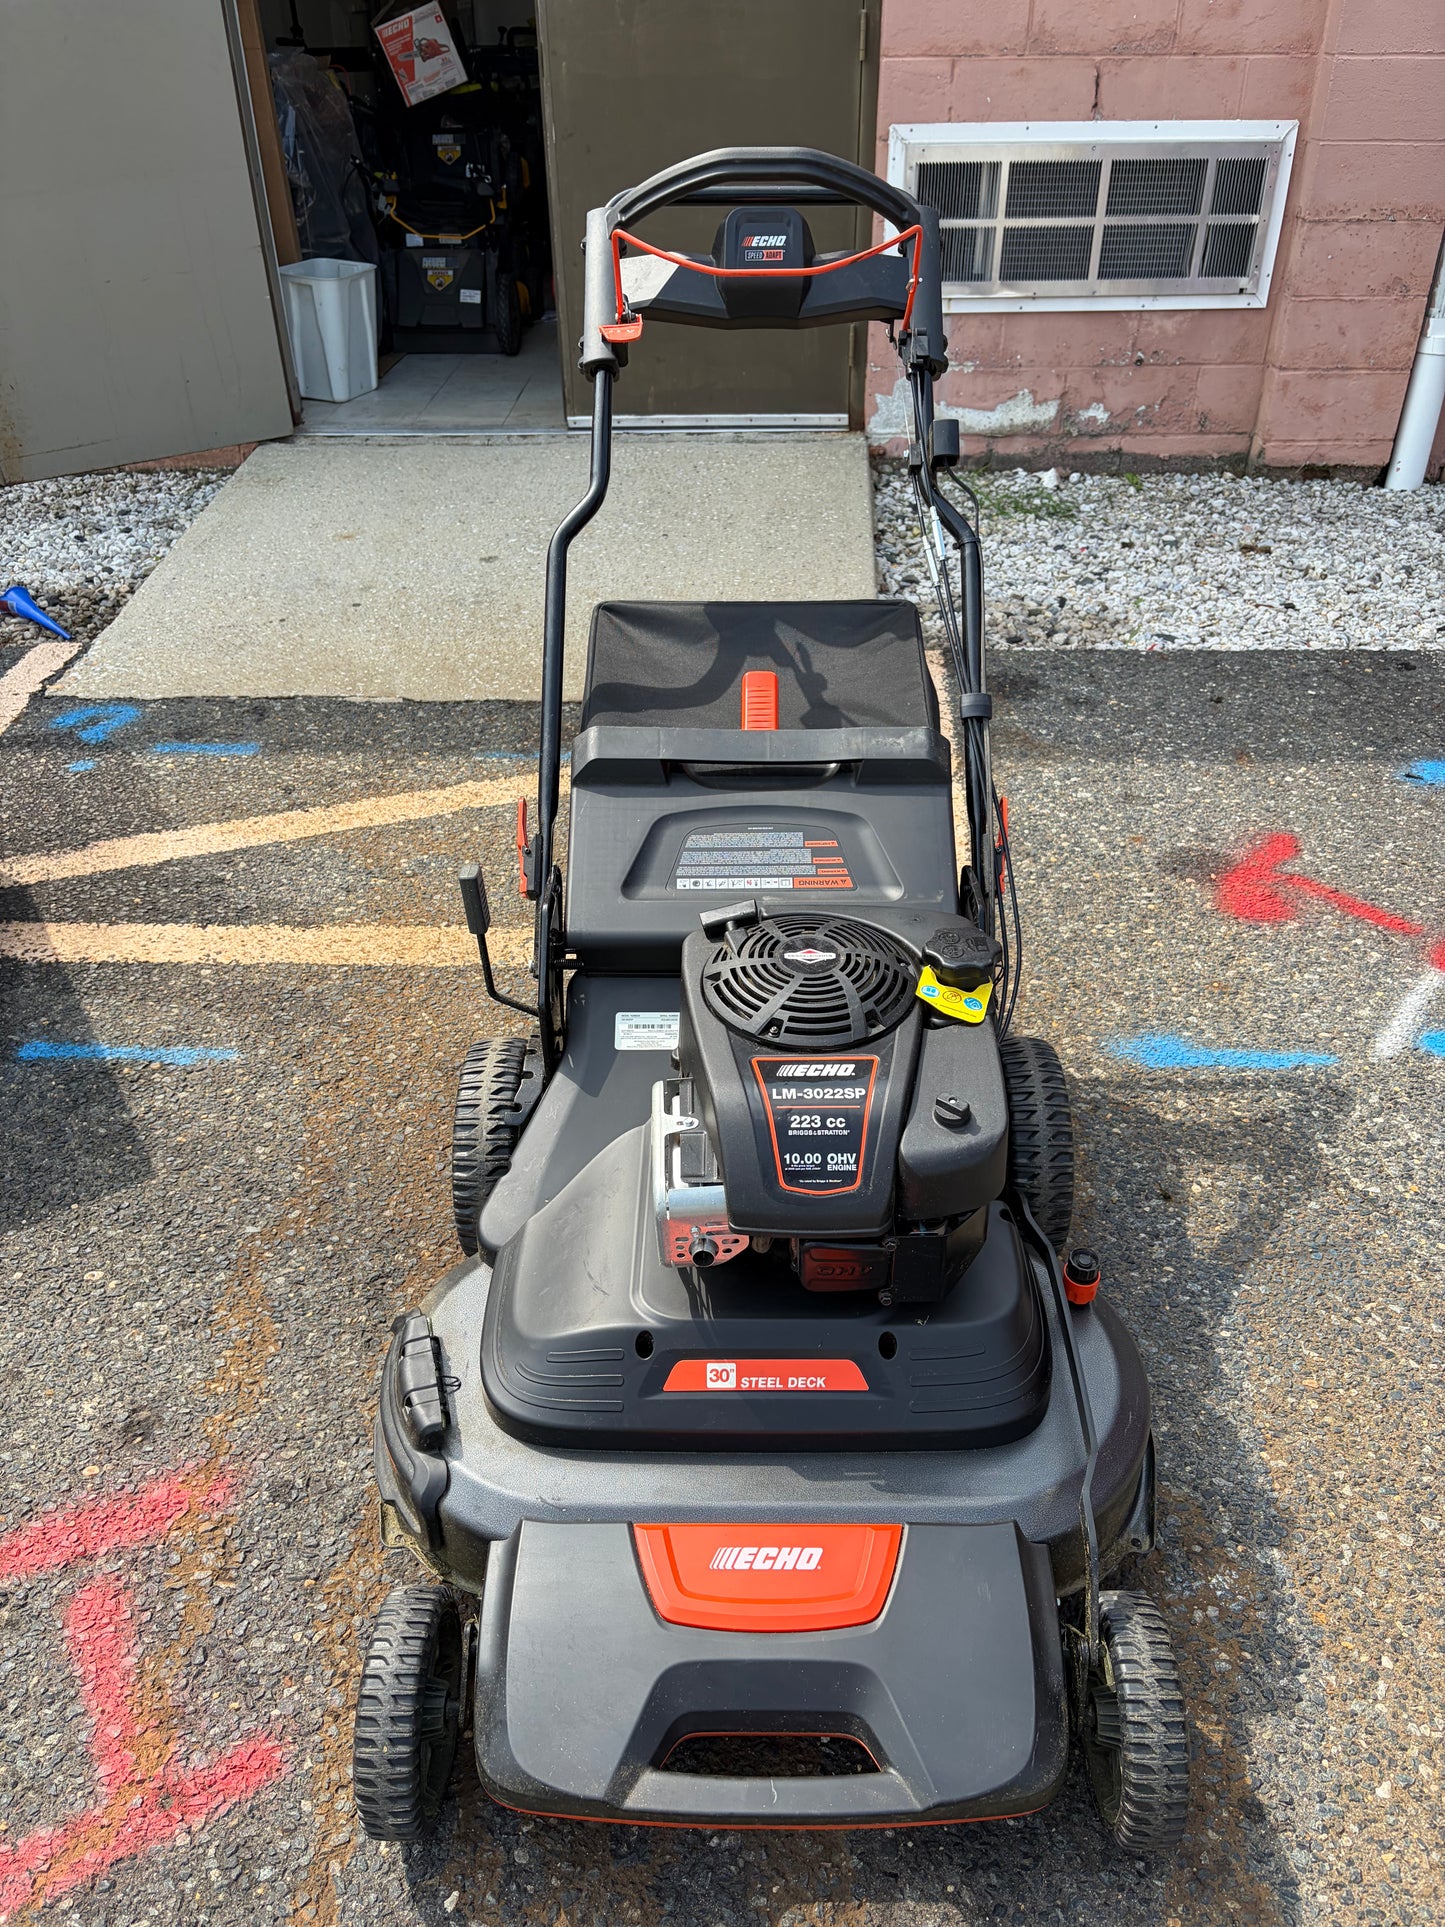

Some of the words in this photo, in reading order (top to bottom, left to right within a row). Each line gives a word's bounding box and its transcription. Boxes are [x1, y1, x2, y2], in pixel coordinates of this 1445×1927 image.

[751, 235, 787, 247] ECHO
[747, 251, 763, 259] SPEED
[794, 1064, 856, 1077] ECHO
[772, 1088, 866, 1100] LM-3022SP
[790, 1115, 821, 1128] 223
[826, 1117, 846, 1128] cc
[783, 1153, 822, 1165] 10.00
[827, 1153, 857, 1164] OHV
[709, 1368, 735, 1383] 30"
[740, 1377, 783, 1388] STEEL
[788, 1377, 827, 1388] DECK
[733, 1547, 824, 1571] ECHO
